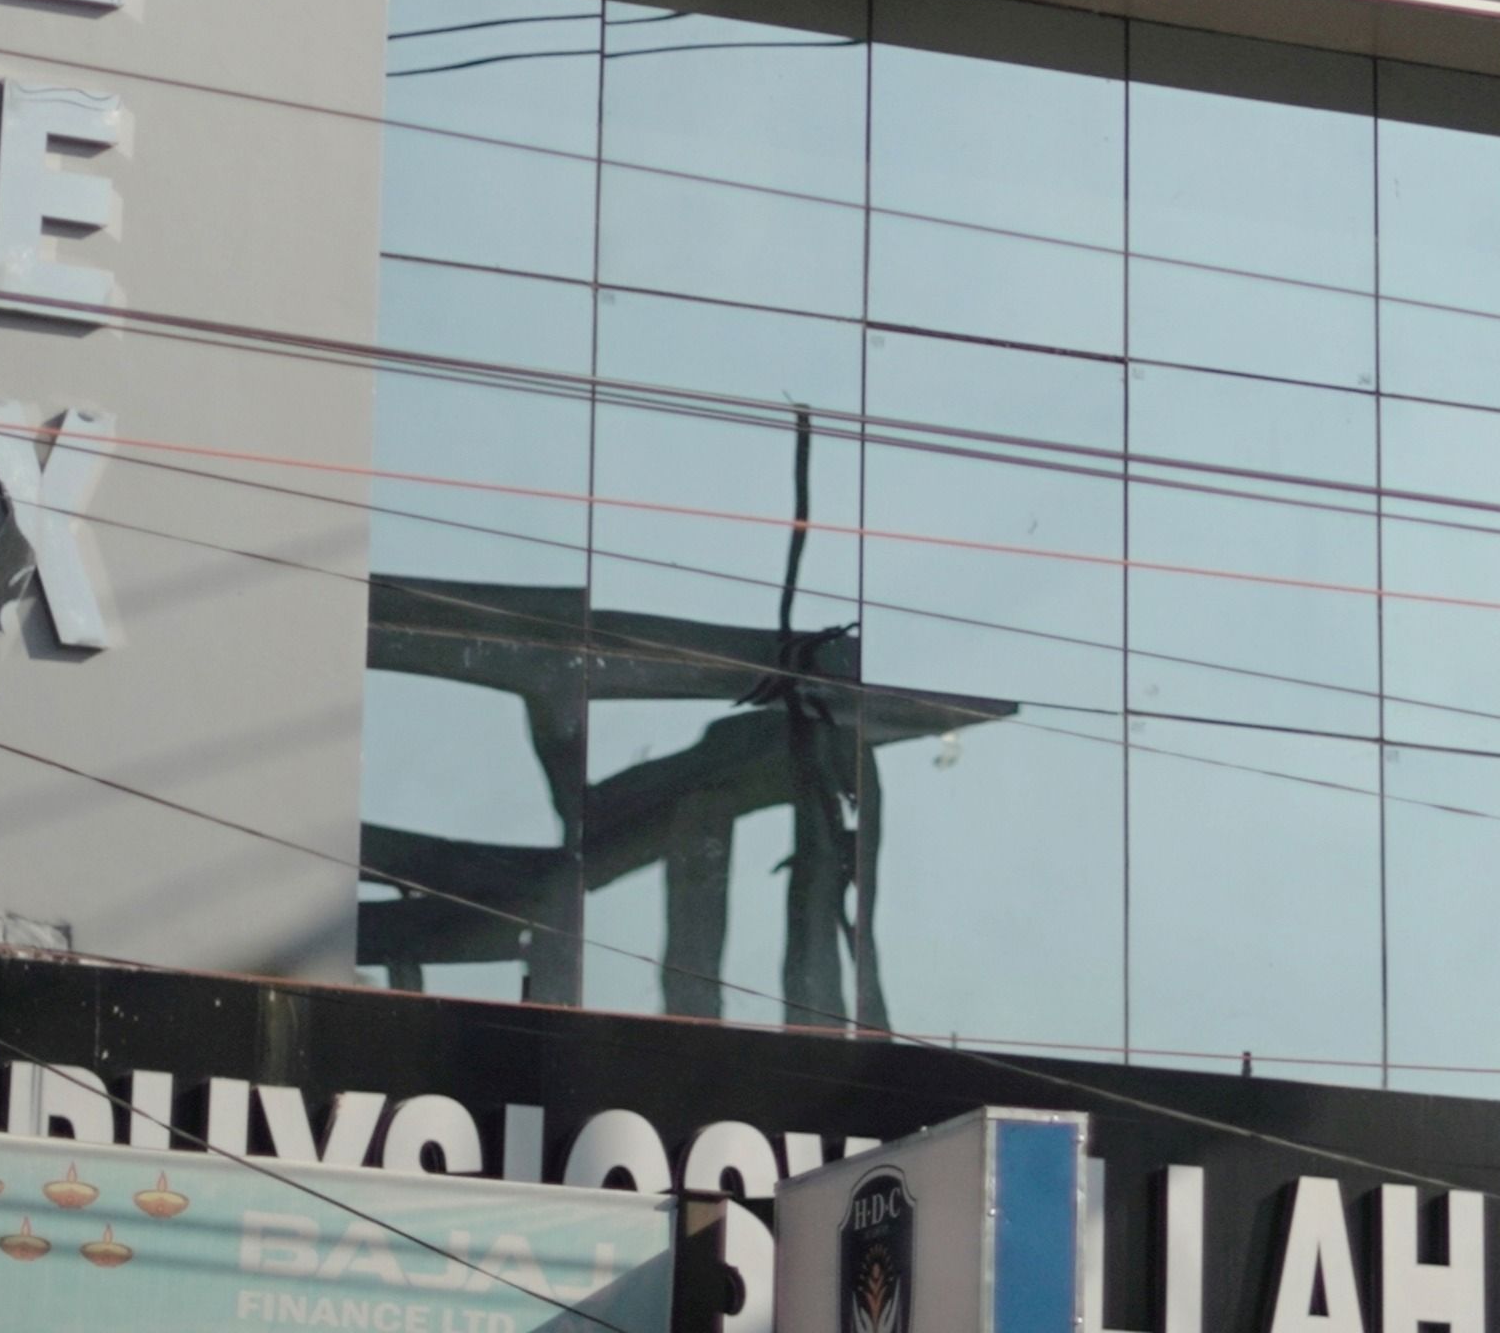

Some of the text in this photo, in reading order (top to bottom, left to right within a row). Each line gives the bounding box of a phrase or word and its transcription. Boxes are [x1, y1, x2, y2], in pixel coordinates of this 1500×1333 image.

[238, 1209, 616, 1303] BAJAJ
[236, 1290, 515, 1333] FINANCE LTD
